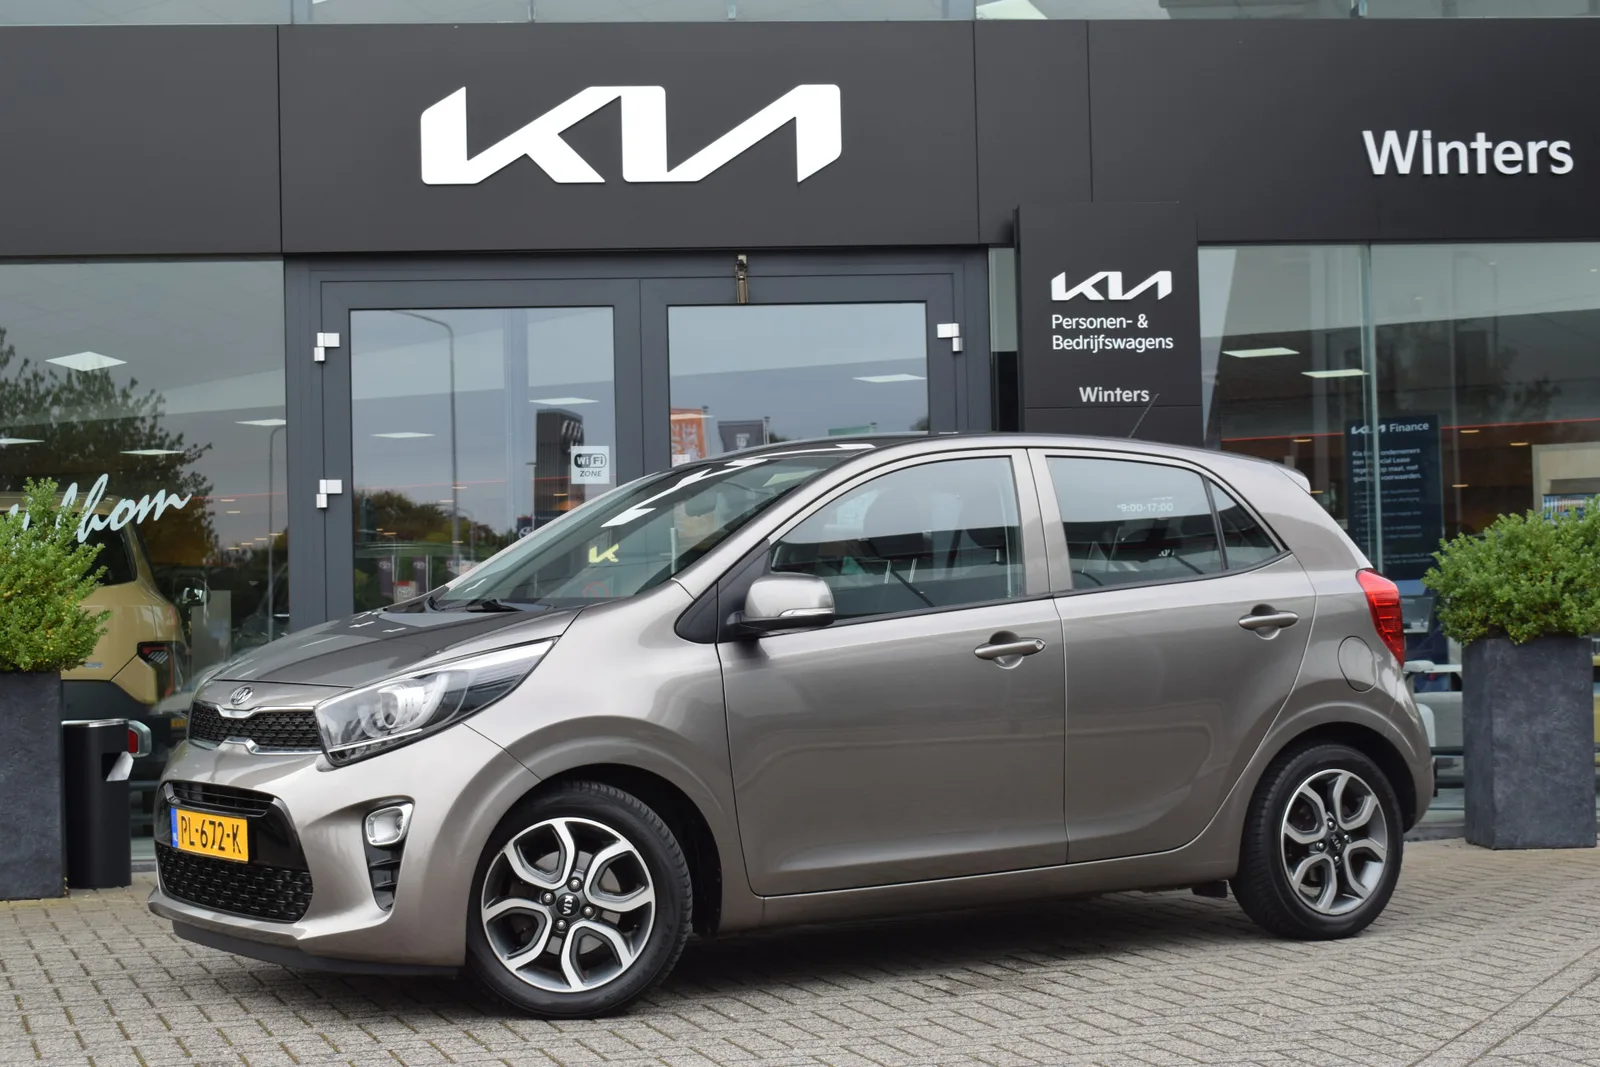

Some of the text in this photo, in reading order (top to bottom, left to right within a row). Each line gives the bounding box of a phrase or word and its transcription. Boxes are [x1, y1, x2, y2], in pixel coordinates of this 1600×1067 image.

[420, 84, 842, 185] KIA
[1362, 130, 1574, 175] Winters
[1051, 270, 1172, 301] KIA
[1052, 313, 1148, 329] Personen- &
[1052, 334, 1174, 353] Bedrijfswagens
[1079, 386, 1150, 402] Winters
[1389, 422, 1430, 433] Finance
[579, 470, 603, 478] ZONE
[180, 815, 242, 855] PL-672-K
[562, 895, 574, 915] KIA
